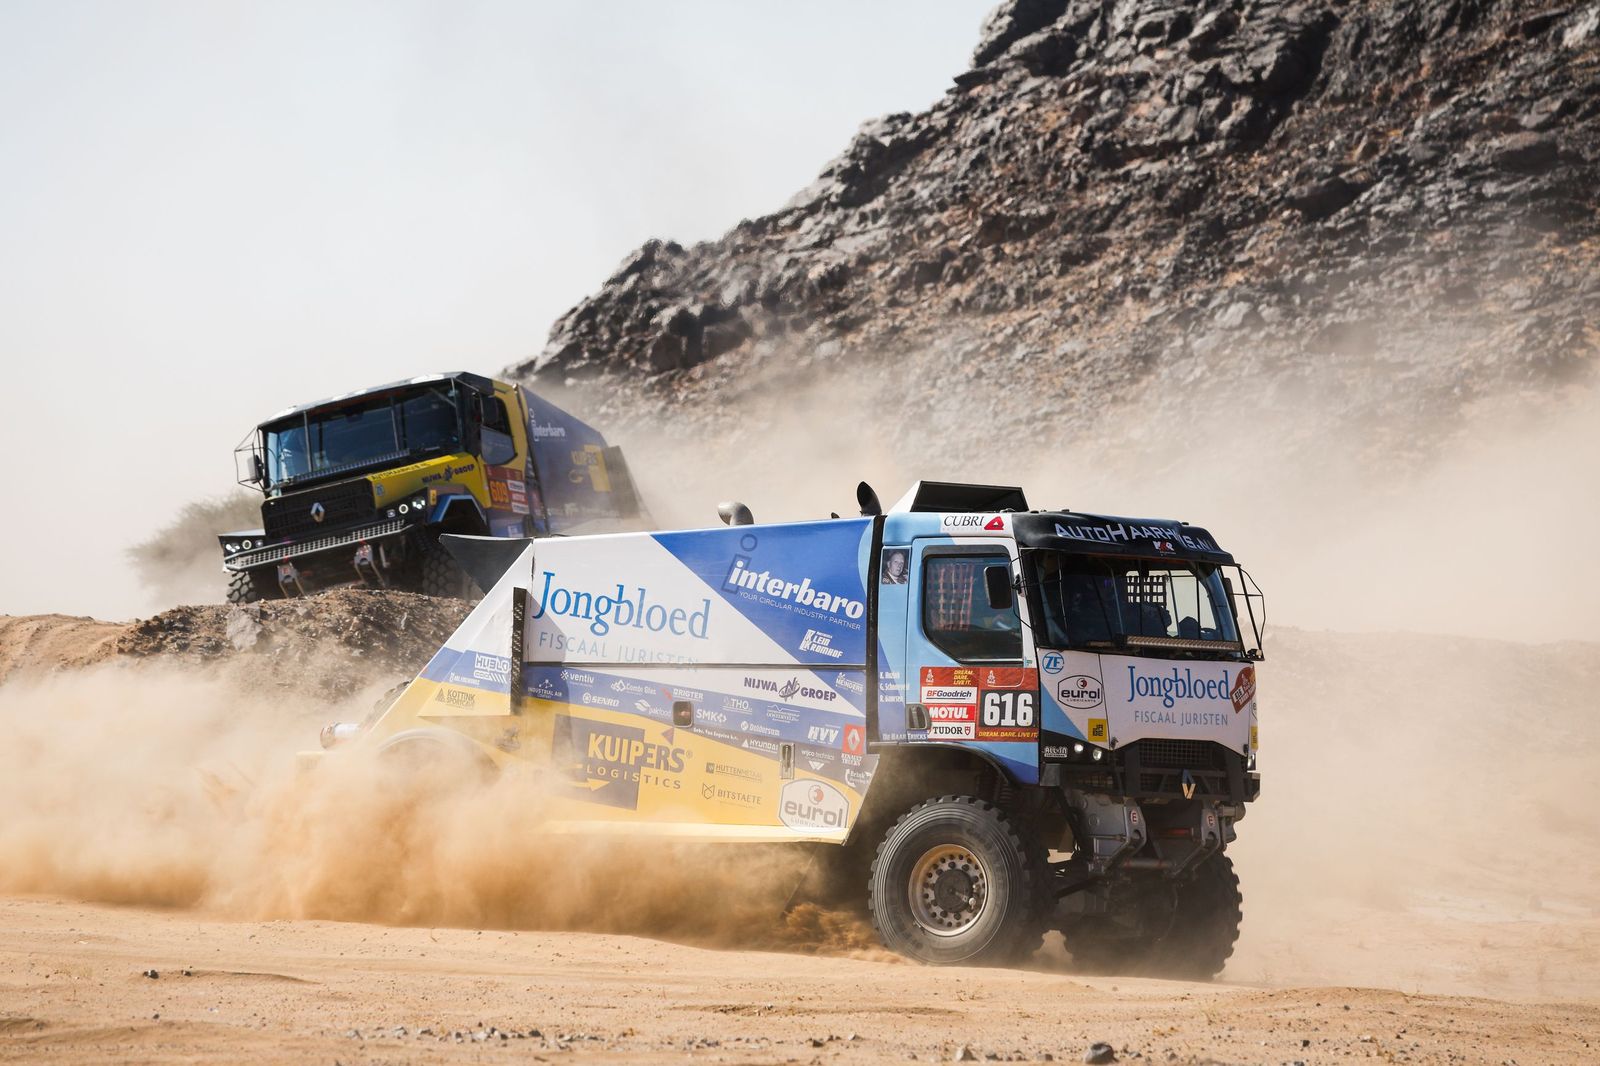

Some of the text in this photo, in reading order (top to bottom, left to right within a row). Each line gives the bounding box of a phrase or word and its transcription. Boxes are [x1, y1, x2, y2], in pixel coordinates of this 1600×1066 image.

[489, 480, 510, 504] 609
[943, 515, 985, 527] CUBRI
[728, 560, 864, 619] interbaro
[531, 571, 712, 641] Jongbloed
[738, 591, 861, 631] YOUR CIRCULAR INDUSTRY PARTNER
[538, 631, 700, 673] FISCAAL JURISTEN
[1045, 655, 1063, 670] ZF
[569, 672, 595, 684] ventiv
[1127, 665, 1231, 708] Jongbloed
[528, 686, 554, 696] INDUSTRIAL
[743, 677, 778, 692] NIJWA
[800, 687, 837, 701] GROEP
[926, 689, 972, 698] BFGoodrich
[1061, 688, 1100, 699] eurol
[695, 709, 718, 722] SMK
[928, 706, 969, 719] MOTUL
[983, 692, 1034, 727] 616
[1134, 710, 1229, 726] FISCAAL JURISTEN
[807, 725, 839, 743] HVV
[933, 726, 963, 735] TUDOR
[587, 732, 686, 774] KUIPERS
[749, 739, 779, 752] HYUNDAI
[841, 752, 863, 761] RENAULT
[586, 764, 682, 790] LOGISTICS
[717, 788, 762, 805] BITSTAETE
[784, 799, 843, 828] eurol
